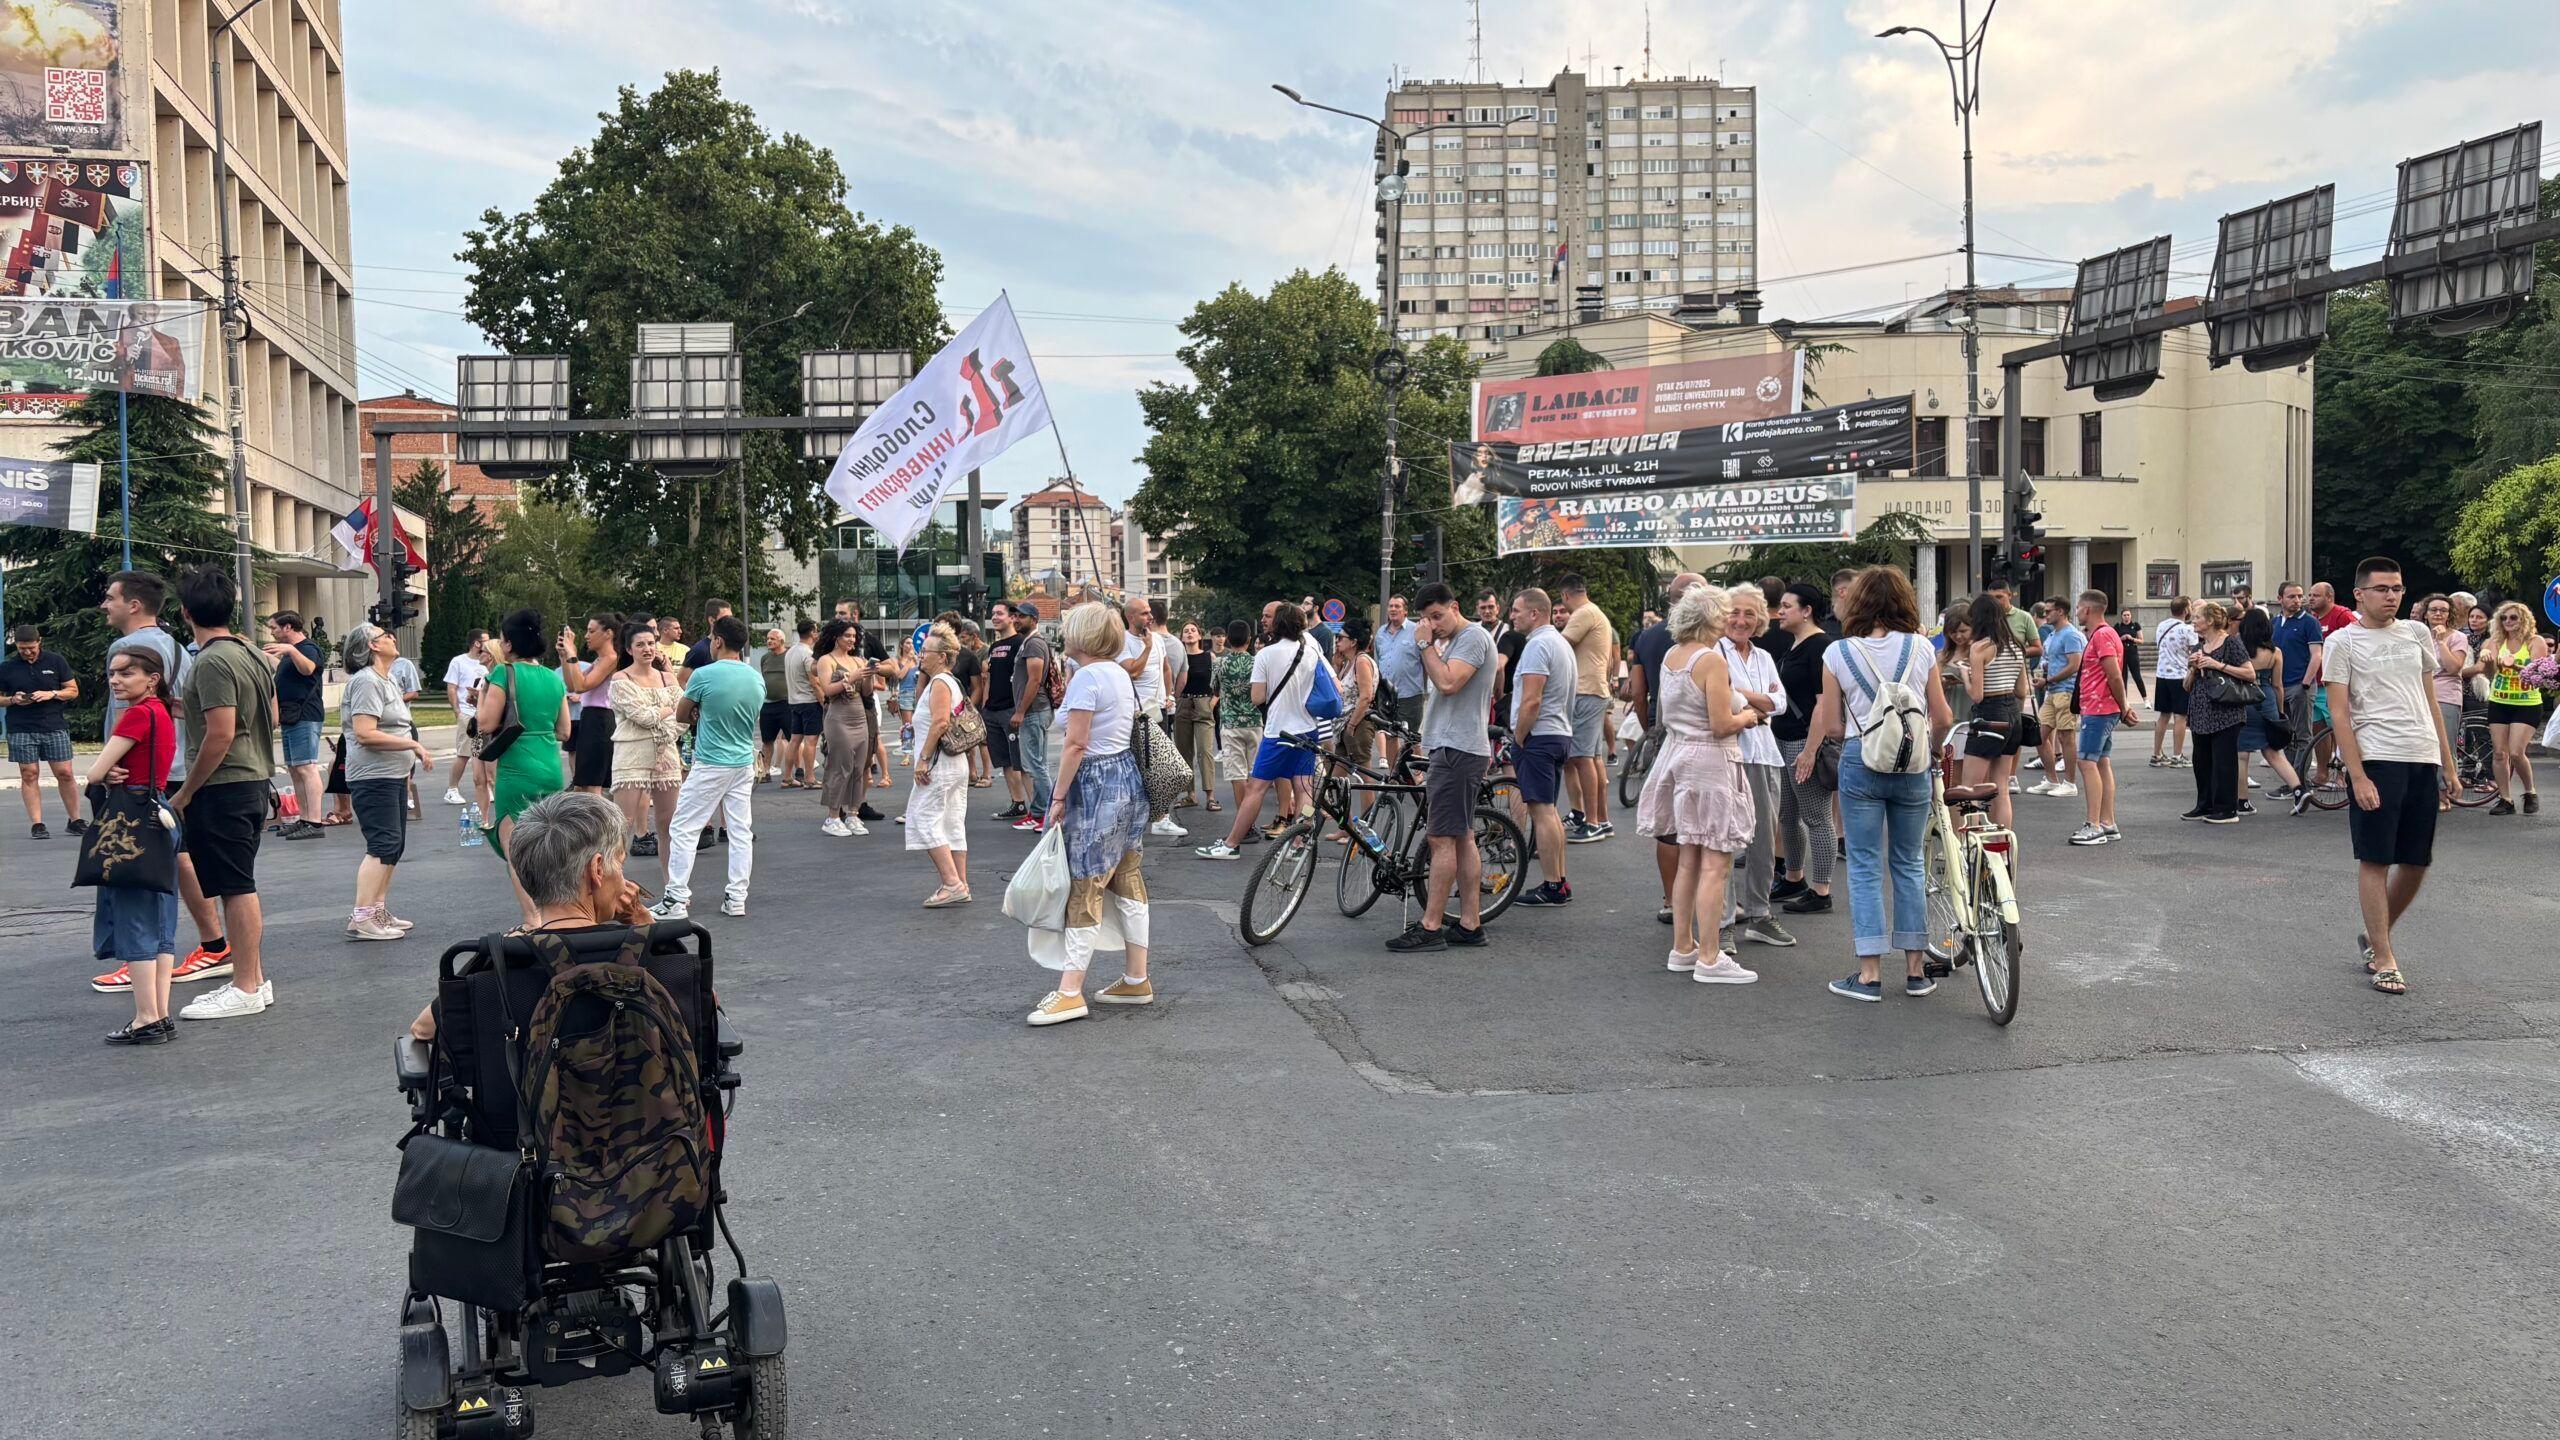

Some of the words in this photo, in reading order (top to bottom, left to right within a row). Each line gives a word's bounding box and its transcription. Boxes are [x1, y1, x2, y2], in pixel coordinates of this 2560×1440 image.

[54, 125, 99, 135] www.vs.rs
[0, 196, 43, 208] РБИЈЕ
[0, 338, 116, 362] KOVIĆ
[135, 372, 171, 386] tickets.rs
[1656, 382, 1674, 391] PETAK
[1675, 379, 1711, 390] 25/07/2025
[1531, 386, 1640, 412] LAIBACH
[1655, 391, 1684, 402] DVORIŠTE
[1684, 389, 1724, 400] UNIVERZITETA
[1724, 388, 1729, 397] U
[1730, 386, 1746, 397] NIŠU
[1654, 404, 1682, 414] ULAZNICE
[1683, 400, 1726, 411] GIGSTIX
[1855, 410, 1862, 418] U
[1862, 405, 1908, 419] organizaciji
[1530, 414, 1556, 424] OPUS
[1561, 412, 1578, 421] DEI
[1582, 407, 1638, 420] REVISITED
[1745, 420, 1766, 429] Karte
[1766, 416, 1800, 427] dostupne
[1854, 417, 1899, 429] FeelBalkan
[1744, 424, 1824, 441] prodajakarata.com
[1528, 468, 1574, 480] PETAK,
[1577, 467, 1595, 477] 11.
[1598, 463, 1623, 476] JUL
[1634, 459, 1659, 472] 21H
[1530, 480, 1569, 493] ROVOVI
[1571, 476, 1602, 490] NIŠKE
[1605, 475, 1657, 487] TVRĐAVE
[1558, 494, 1664, 517] RAMBO
[1669, 484, 1828, 510] AMADEUS
[1715, 506, 1755, 514] TRIBUTE
[1609, 521, 1631, 533] 12.
[1633, 519, 1668, 532] JUL
[1689, 512, 1795, 529] BANOVINA
[1799, 508, 1836, 524] NIŠ
[1656, 531, 1704, 539] PIVNICA
[1712, 529, 1750, 537] NEMIR
[1773, 526, 1833, 534] BILET.RS
